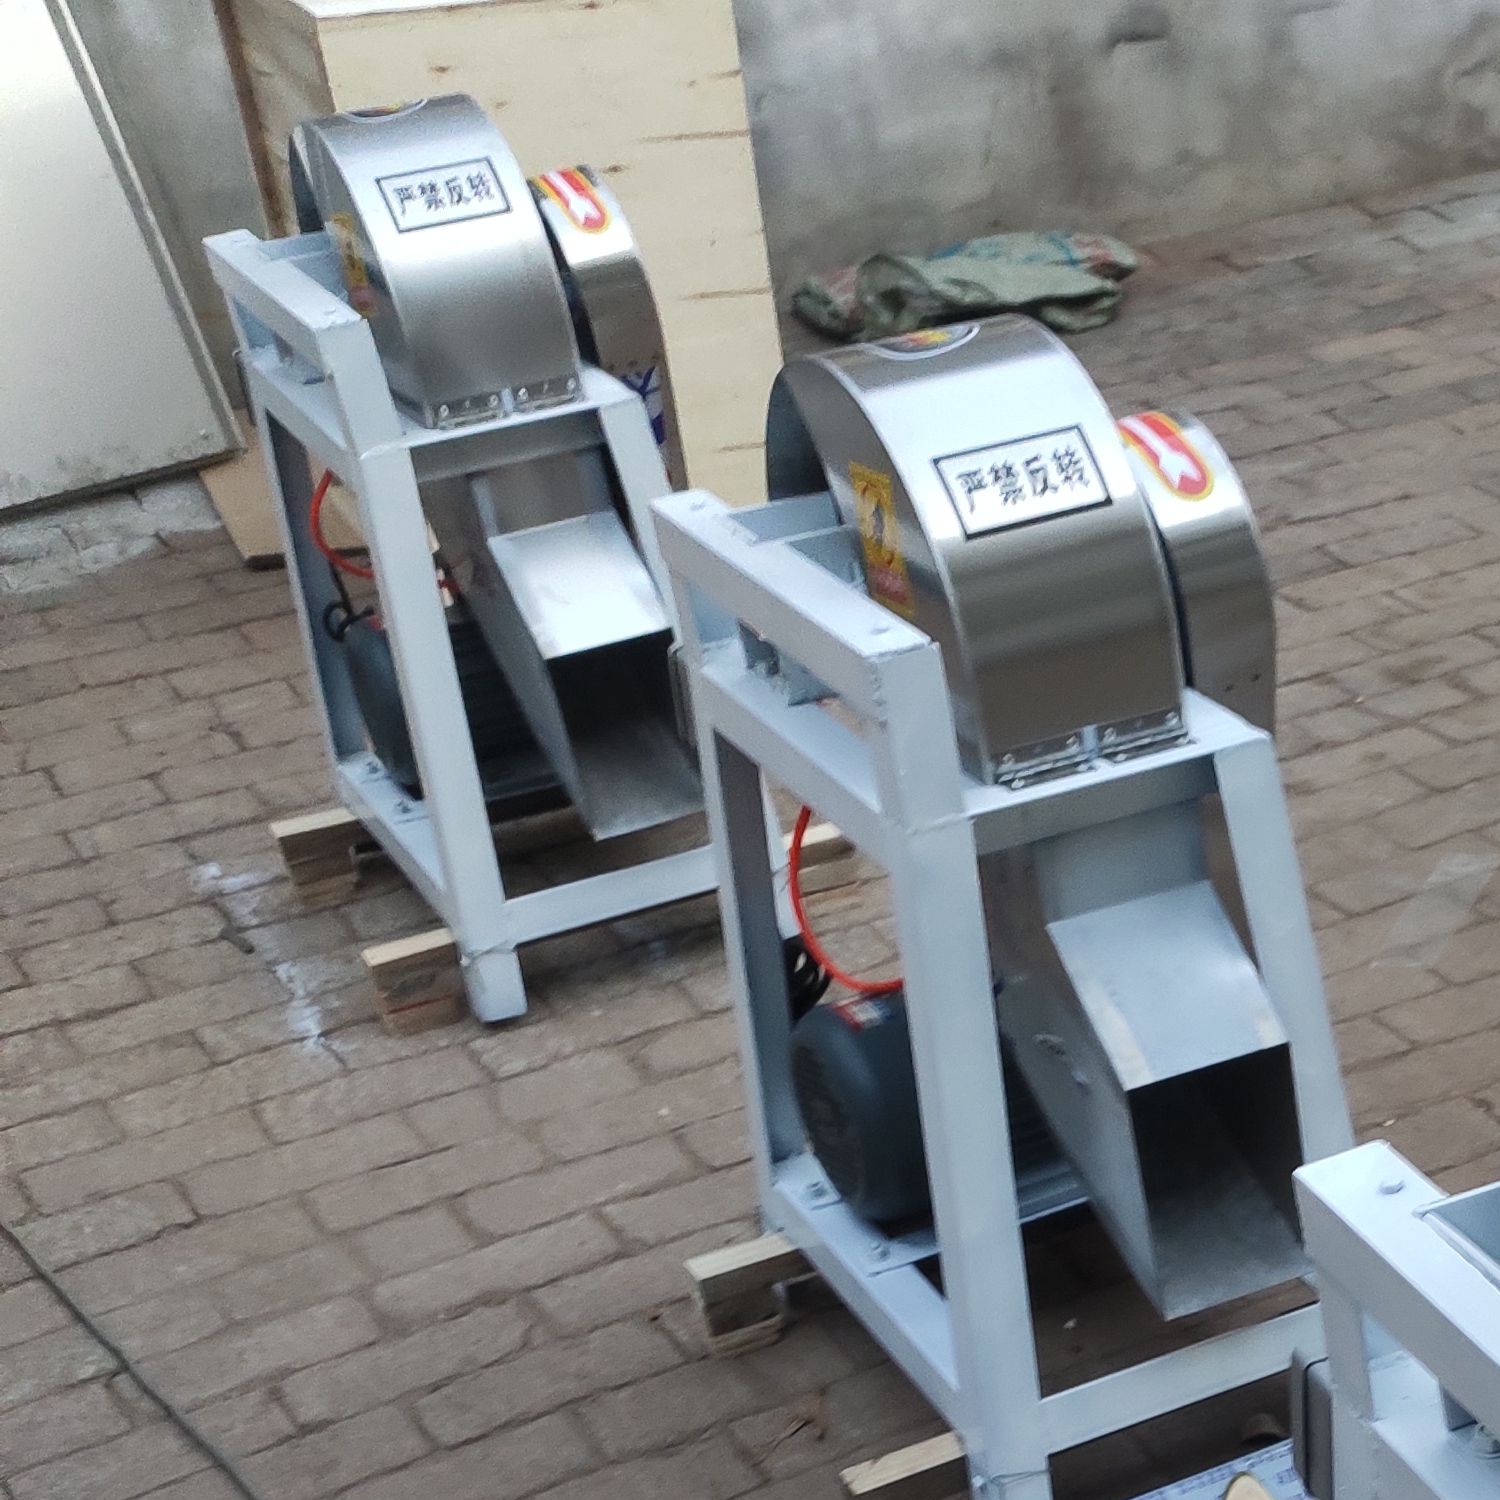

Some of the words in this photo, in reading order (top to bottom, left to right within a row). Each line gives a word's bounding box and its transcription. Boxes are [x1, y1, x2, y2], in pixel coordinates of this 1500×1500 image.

[394, 171, 494, 217] 严禁反转
[957, 445, 1090, 514] 严禁反转
